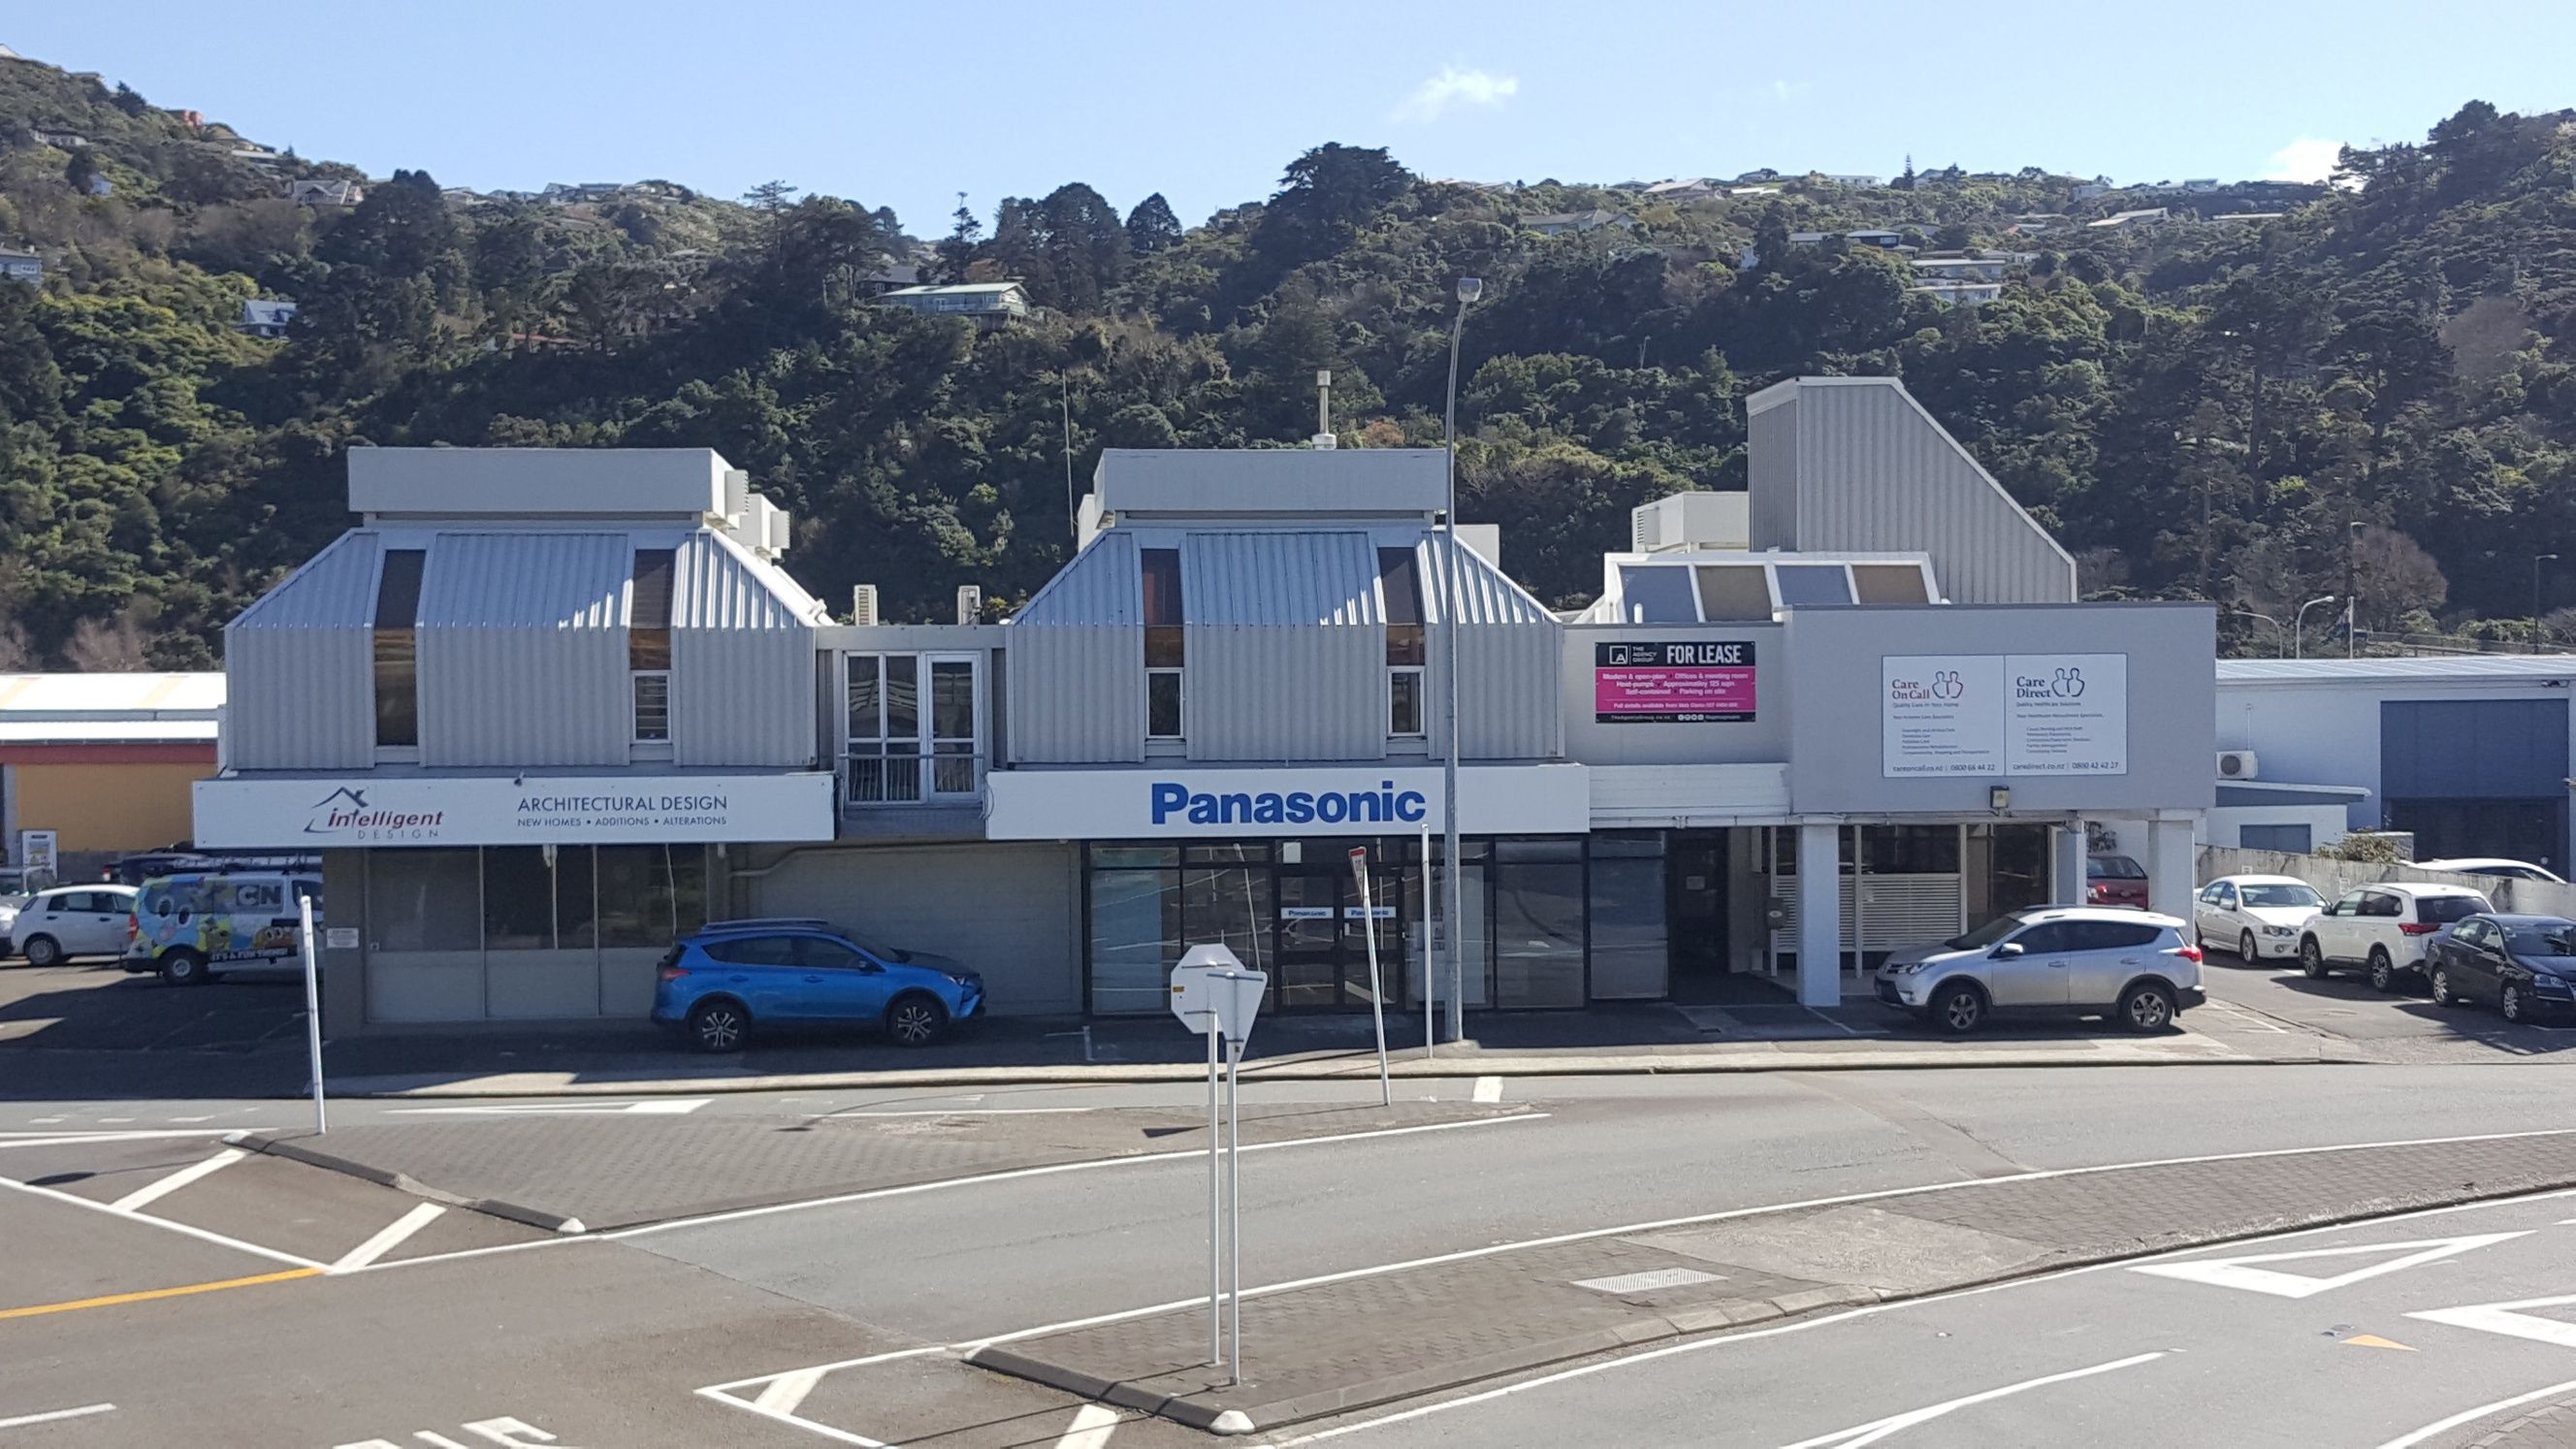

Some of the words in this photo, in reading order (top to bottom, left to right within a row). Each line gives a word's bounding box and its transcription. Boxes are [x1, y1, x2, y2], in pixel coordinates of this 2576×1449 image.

[1667, 645, 1694, 664] FOR
[1698, 645, 1742, 664] LEASE
[1892, 679, 1919, 689] Care
[2016, 676, 2045, 687] Care
[1892, 690, 1908, 699] On
[1909, 689, 1930, 699] Call
[2016, 688, 2051, 698] Direct
[518, 796, 656, 812] ARCHITECTURAL
[661, 795, 727, 810] DESIGN
[1152, 781, 1426, 824] Panasonic
[328, 808, 444, 830] intelligent
[518, 818, 542, 827] NEW
[544, 818, 582, 827] HOMES
[594, 817, 650, 826] ADDITIONS
[662, 816, 727, 825] ALTERATIONS
[357, 829, 439, 839] DESIGN
[236, 884, 284, 906] CN
